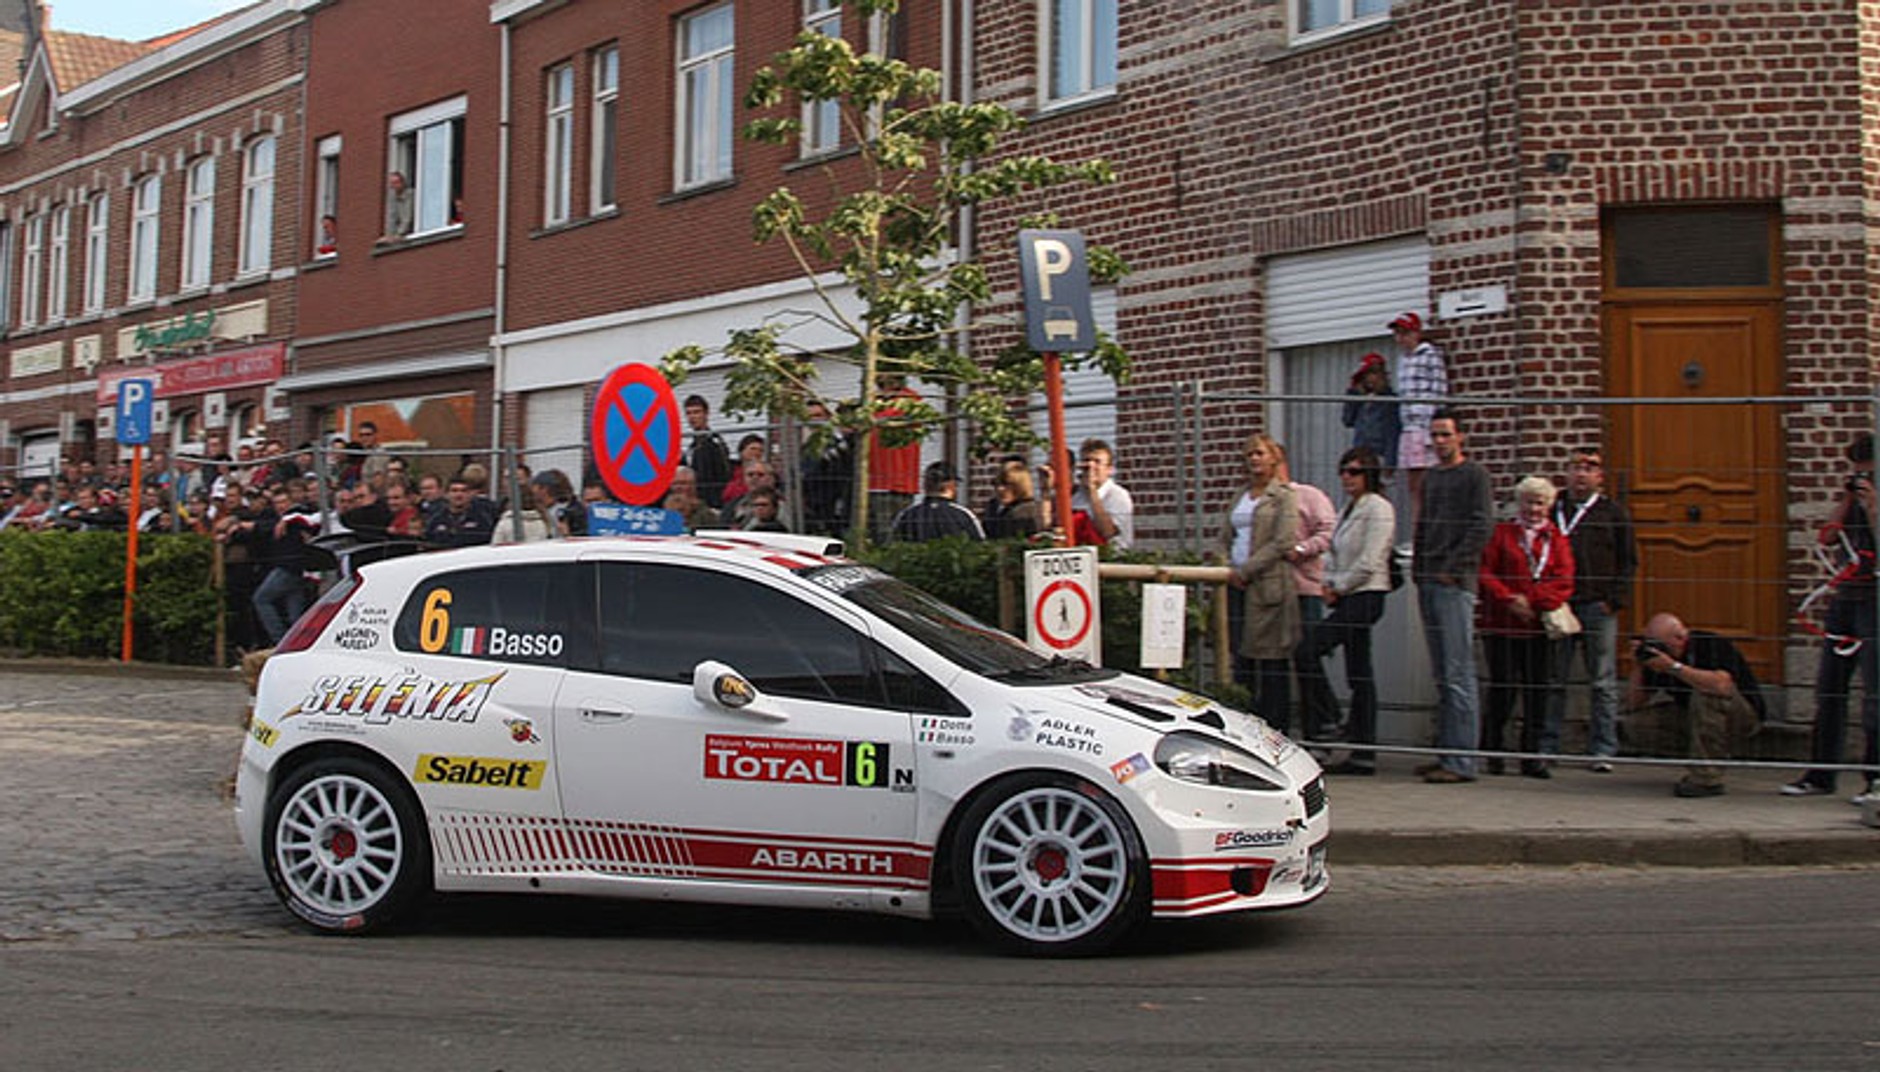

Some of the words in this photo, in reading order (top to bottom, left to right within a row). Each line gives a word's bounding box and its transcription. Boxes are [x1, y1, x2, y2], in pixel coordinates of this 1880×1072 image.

[1034, 239, 1073, 300] P
[124, 383, 145, 416] P
[1042, 556, 1082, 577] ZONE
[420, 587, 453, 653] 6
[489, 627, 563, 656] Basso
[936, 732, 975, 745] Basso
[1041, 718, 1097, 738] ADLER
[1036, 732, 1104, 756] PLASTIC
[425, 756, 533, 788] Sabelt
[709, 749, 838, 782] TOTAL
[855, 741, 876, 787] 6
[895, 768, 913, 785] N
[1215, 830, 1294, 846] BFGoodrich
[751, 848, 893, 873] ABARTH
